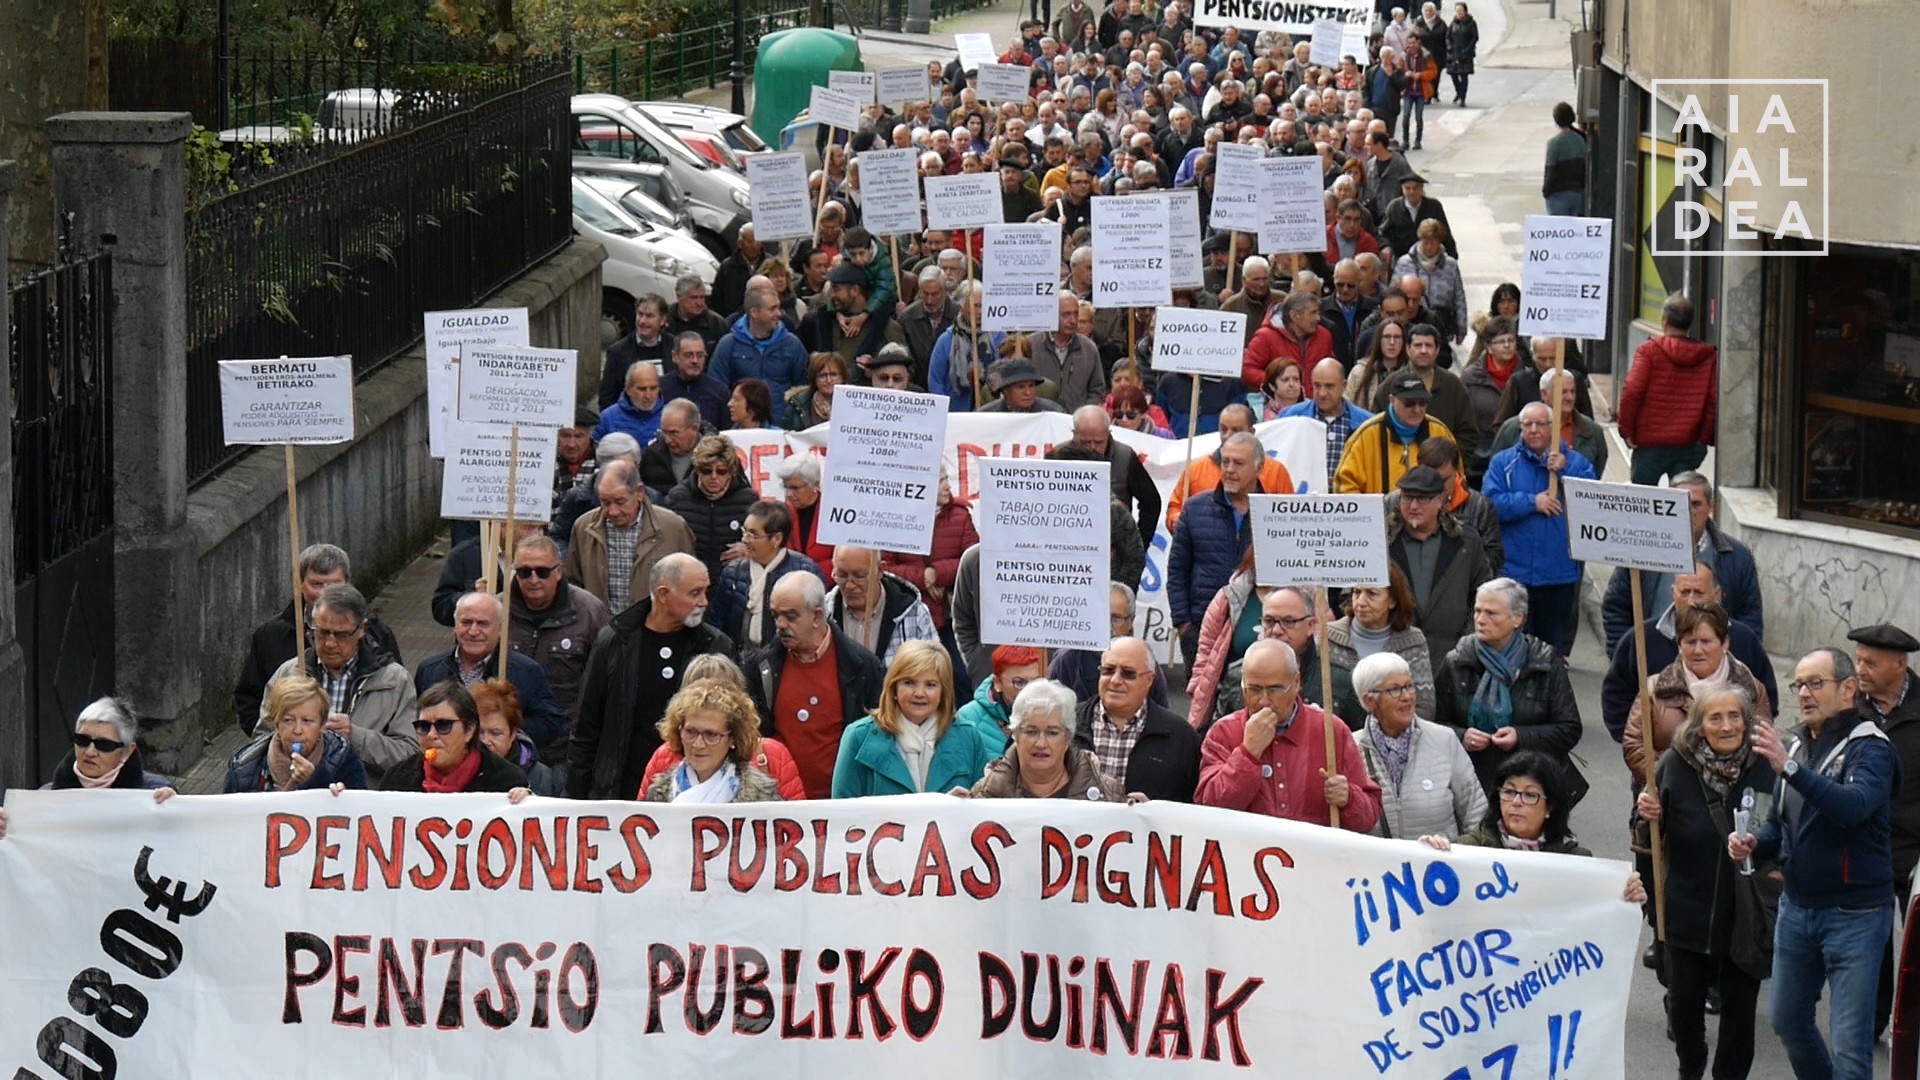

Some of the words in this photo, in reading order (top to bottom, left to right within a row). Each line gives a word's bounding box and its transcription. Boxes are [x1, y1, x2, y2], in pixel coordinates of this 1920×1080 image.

[1247, 193, 1257, 203] EZ
[1214, 209, 1227, 218] NO
[1530, 229, 1583, 240] KOPAGO
[1586, 225, 1602, 237] EZ
[1529, 249, 1549, 261] NO
[1551, 252, 1561, 261] AL
[1565, 251, 1604, 260] COPAGO
[1147, 258, 1163, 269] EZ
[1035, 282, 1054, 295] EZ
[1100, 281, 1118, 292] NO
[1580, 284, 1601, 299] EZ
[987, 305, 1007, 318] NO
[1526, 306, 1549, 321] NO
[442, 315, 509, 328] IGUALDAD
[1161, 323, 1217, 333] KOPAGO
[1220, 321, 1237, 333] EZ
[1160, 343, 1180, 355] NO
[1197, 347, 1237, 356] COPAGO
[472, 352, 513, 360] PENTSIOEN
[515, 354, 566, 363] ERREFORMAK
[251, 363, 317, 375] BERMATU
[479, 359, 558, 372] INDARGABETU
[523, 371, 544, 379] 2013
[257, 380, 314, 389] BETIRAKO
[485, 386, 547, 398] DEROGACIÓN
[469, 394, 509, 402] REFORMAS
[510, 396, 521, 404] DE
[523, 397, 563, 406] PENSIONES
[845, 391, 896, 403] GUTXIENGO
[898, 395, 936, 407] SOLDATA
[250, 401, 322, 412] GARANTIZAR
[488, 402, 511, 411] 2011
[521, 404, 545, 413] 2013
[852, 400, 891, 412] SALARIO
[233, 420, 275, 428] PENSIONES
[304, 417, 345, 426] SIEMPRE
[873, 412, 903, 422] 1200€
[840, 425, 889, 437] GUTXIENGO
[891, 430, 933, 442] PENTSIOA
[460, 448, 502, 457] PENTSIO
[504, 450, 542, 459] DINAK
[869, 447, 899, 457] 1080€
[459, 458, 542, 469] ALARGUNETZAT
[990, 468, 1050, 479] LANPOSTU
[1054, 471, 1098, 481] DUINAK
[833, 475, 903, 489] IRAUNKORTASUN
[904, 483, 927, 500] EZ
[853, 485, 902, 498] FAKTORIK
[996, 480, 1045, 491] PENTSIO
[1048, 482, 1092, 492] DUINAK
[476, 495, 494, 503] LAS
[1575, 490, 1650, 505] IRAUNKORTASUN
[1652, 499, 1678, 517] EZ
[1000, 501, 1044, 515] TABAJO
[1047, 503, 1089, 515] DIGNO
[1271, 501, 1359, 513] IGUALDAD
[1598, 502, 1651, 514] FAKTORIK
[830, 507, 857, 524] NO
[857, 510, 869, 518] AL
[870, 510, 903, 521] FACTOR
[905, 514, 918, 522] DE
[1290, 515, 1324, 524] MUJERES
[857, 518, 925, 532] SOSTENIBILIDAD
[1052, 516, 1093, 528] DIGNA
[1267, 528, 1295, 539] Igual
[1299, 528, 1342, 539] trabajo
[1580, 524, 1608, 541] NO
[1622, 529, 1658, 539] FACTOR
[1660, 532, 1673, 540] DE
[1044, 543, 1099, 551] PENTSIONISTAK
[1296, 538, 1326, 549] Igual
[1329, 538, 1369, 548] salario
[1610, 535, 1684, 550] SOSTENIBILIDAD
[996, 561, 1045, 572] PENTSIO
[1048, 563, 1092, 574] DUINAK
[1275, 559, 1309, 568] IGUAL
[1314, 557, 1366, 568] PENSIÓN
[996, 573, 1093, 586] ALARGUNENTZAT
[1000, 593, 1049, 605] PENSIÓN
[1052, 595, 1088, 607] DIGNA
[1020, 606, 1078, 618] VIUDEDAD
[997, 619, 1015, 627] PARA
[1019, 619, 1040, 629] LAS
[1042, 620, 1091, 632] MUJERES
[1044, 638, 1099, 647] PENTSIONISTAK
[265, 812, 660, 894] PENSiONES
[690, 815, 1015, 899] PUBLiCAS
[1040, 826, 1294, 921] DiGNAS
[1475, 861, 1519, 901] al
[1370, 928, 1520, 1017] FACTOR
[282, 931, 602, 1034] PENTSiO
[643, 942, 946, 1042] PUBLiKO
[978, 951, 1264, 1068] DUiNAK
[1362, 1028, 1413, 1074] DE
